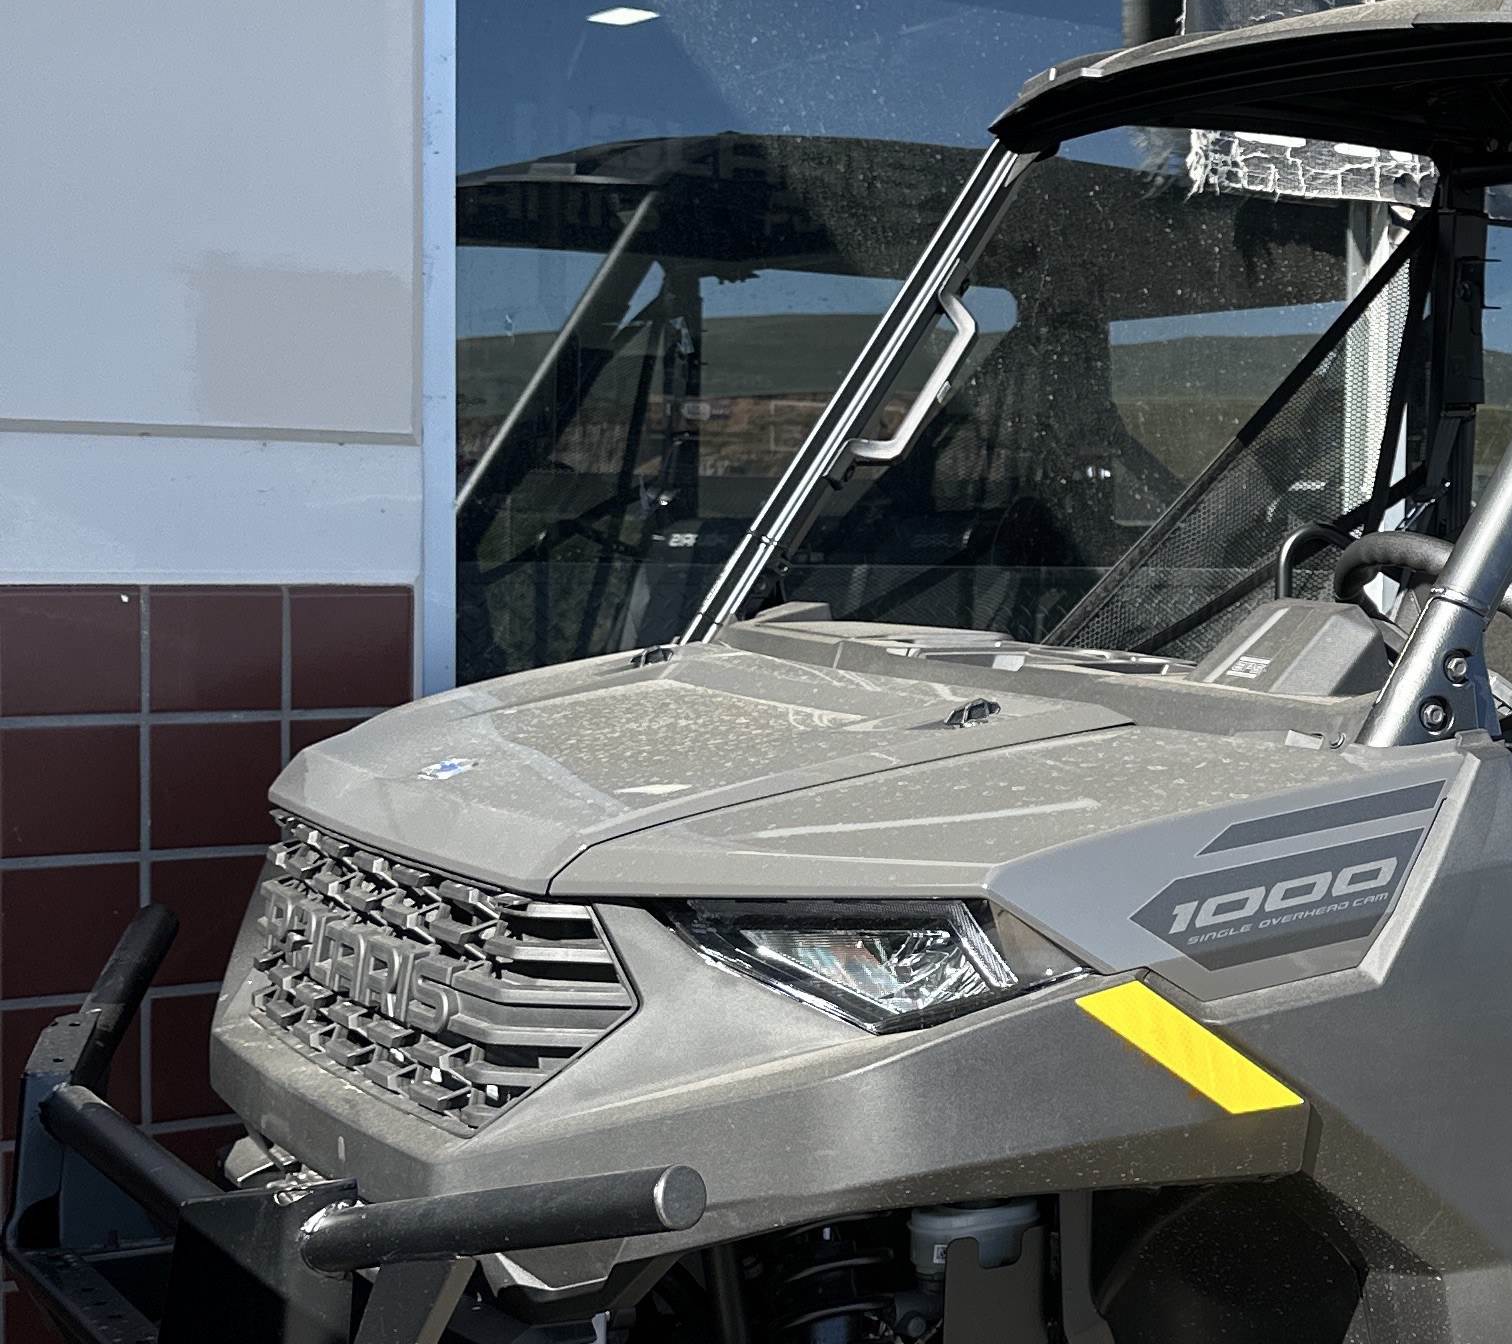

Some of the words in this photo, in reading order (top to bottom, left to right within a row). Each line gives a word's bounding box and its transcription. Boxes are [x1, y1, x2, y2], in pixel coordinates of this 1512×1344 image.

[1167, 856, 1399, 935] 1000
[1186, 923, 1252, 946] SINGLE
[1258, 899, 1351, 931] OVERHEAD
[1353, 891, 1390, 909] CAM
[260, 881, 452, 1034] POLARIS
